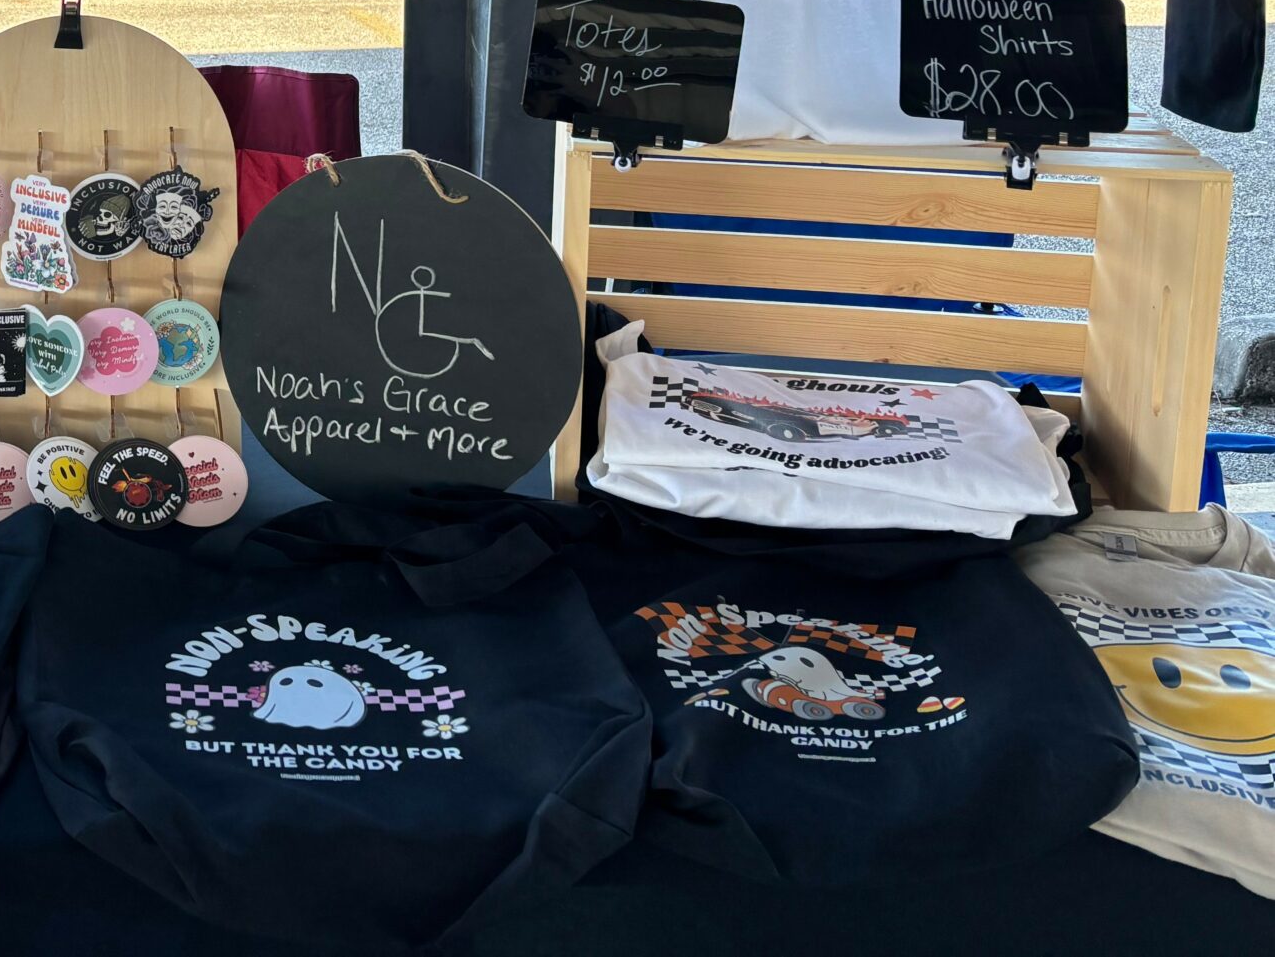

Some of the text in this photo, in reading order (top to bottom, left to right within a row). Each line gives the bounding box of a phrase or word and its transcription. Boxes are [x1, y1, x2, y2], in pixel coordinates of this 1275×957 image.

[978, 23, 1075, 57] Shirts
[579, 62, 669, 107] $12.00
[923, 56, 1074, 120] $28.00
[15, 183, 67, 205] INCLUSIVE
[20, 202, 60, 221] DEMURE
[17, 218, 61, 238] MINDFUL
[78, 238, 104, 253] NOT
[156, 307, 180, 322] WORLD
[181, 307, 205, 322] SHOULD
[153, 365, 202, 381] ORE INCLUSIVE
[255, 365, 494, 422] Noah's Grace
[786, 376, 902, 397] ghouls
[262, 406, 383, 456] Apparel
[426, 426, 514, 461] More
[662, 414, 951, 470] We're going advocating!
[36, 444, 86, 465] BE POSITIVE
[97, 446, 169, 486] FEEL THE SPEED.
[184, 456, 219, 476] pecial
[187, 486, 223, 504] Mom
[115, 492, 182, 525] NO LIMITS
[1123, 606, 1199, 620] VIBES
[695, 699, 968, 739] BUT THANK YOU FOR THE
[185, 740, 464, 761] BUT THANK YOU FOR
[790, 735, 873, 751] CANDY
[247, 755, 404, 773] THE CANDY
[1143, 769, 1275, 811] NCLUSIVE
